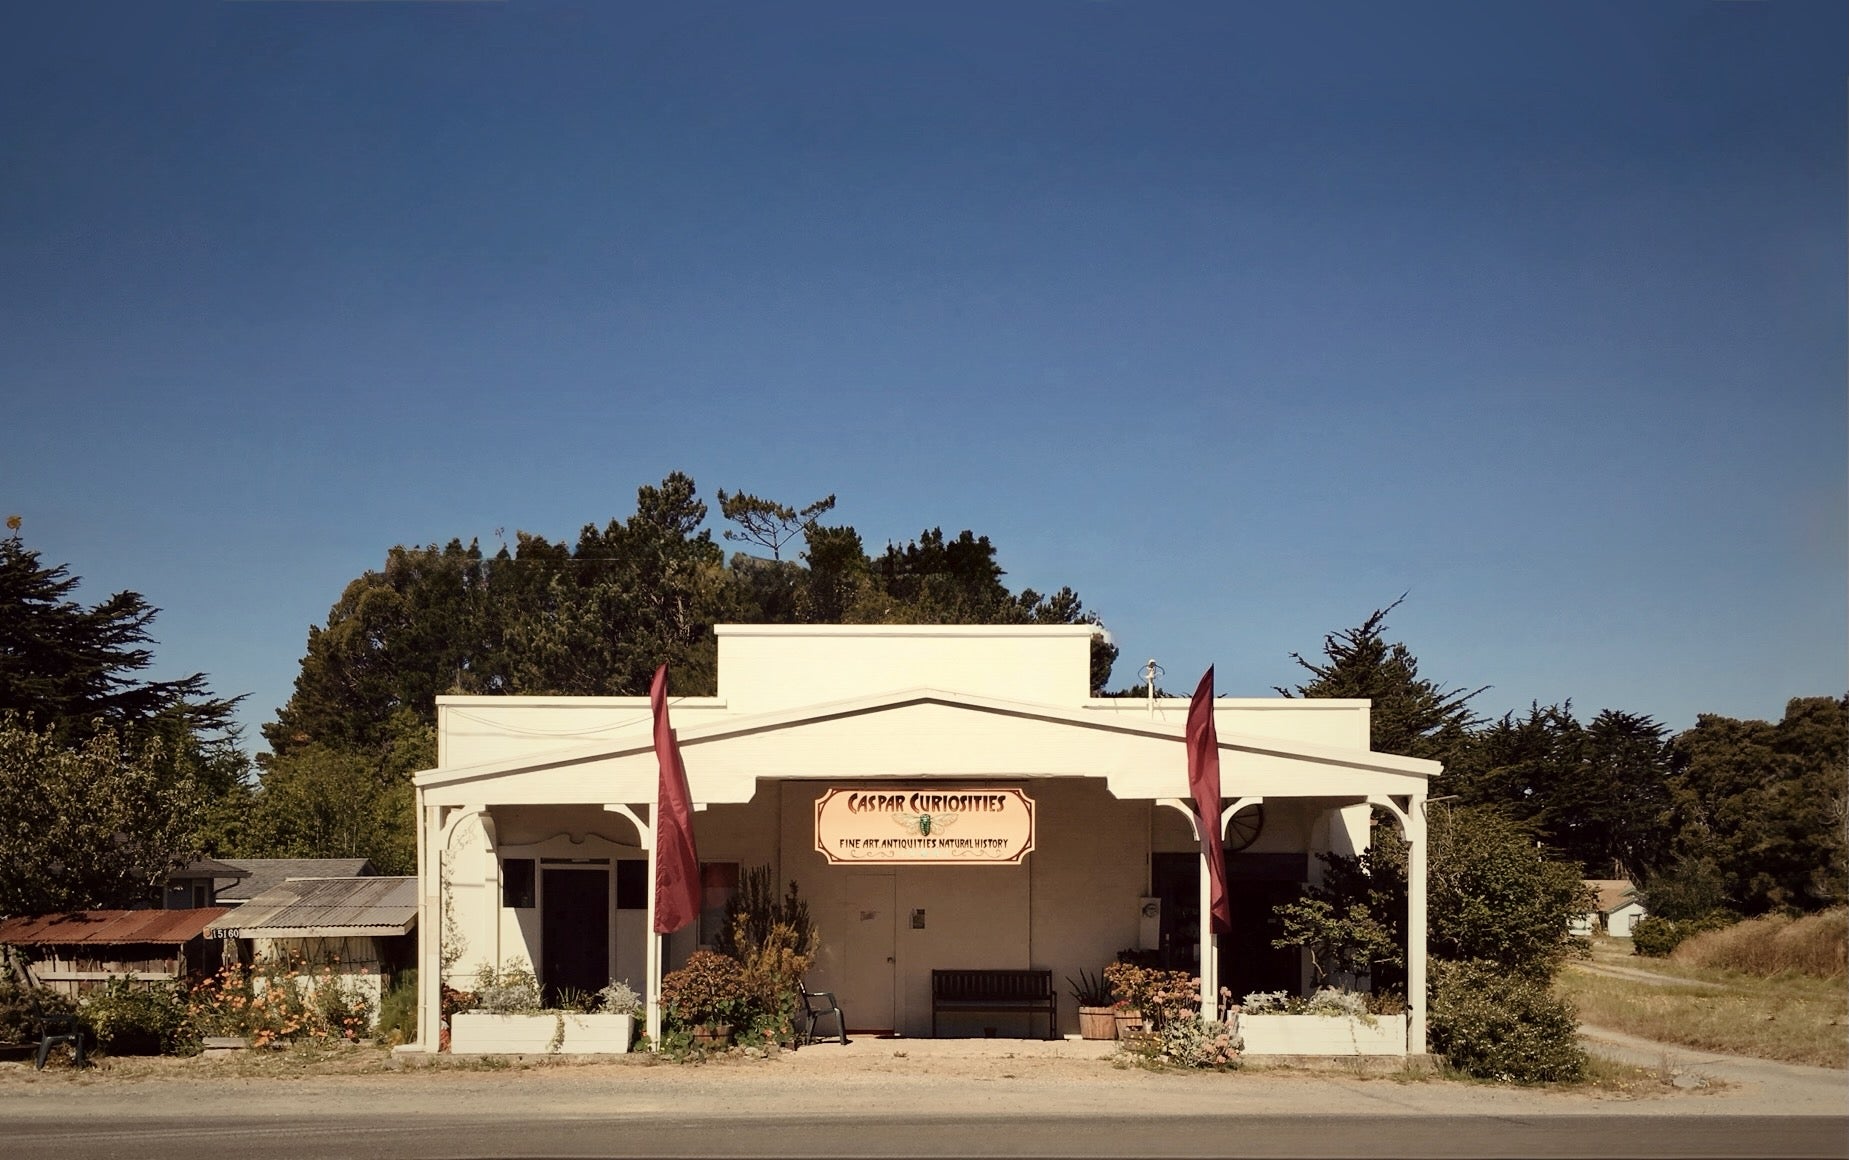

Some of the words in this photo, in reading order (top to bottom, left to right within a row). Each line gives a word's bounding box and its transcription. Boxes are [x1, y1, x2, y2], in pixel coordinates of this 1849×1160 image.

[848, 793, 905, 814] CASPAR
[910, 793, 1006, 813] CURIOSITIES
[840, 839, 860, 848] FINE
[939, 839, 973, 848] NATURAL
[975, 839, 1008, 848] HISTORY
[213, 929, 239, 938] 15160
